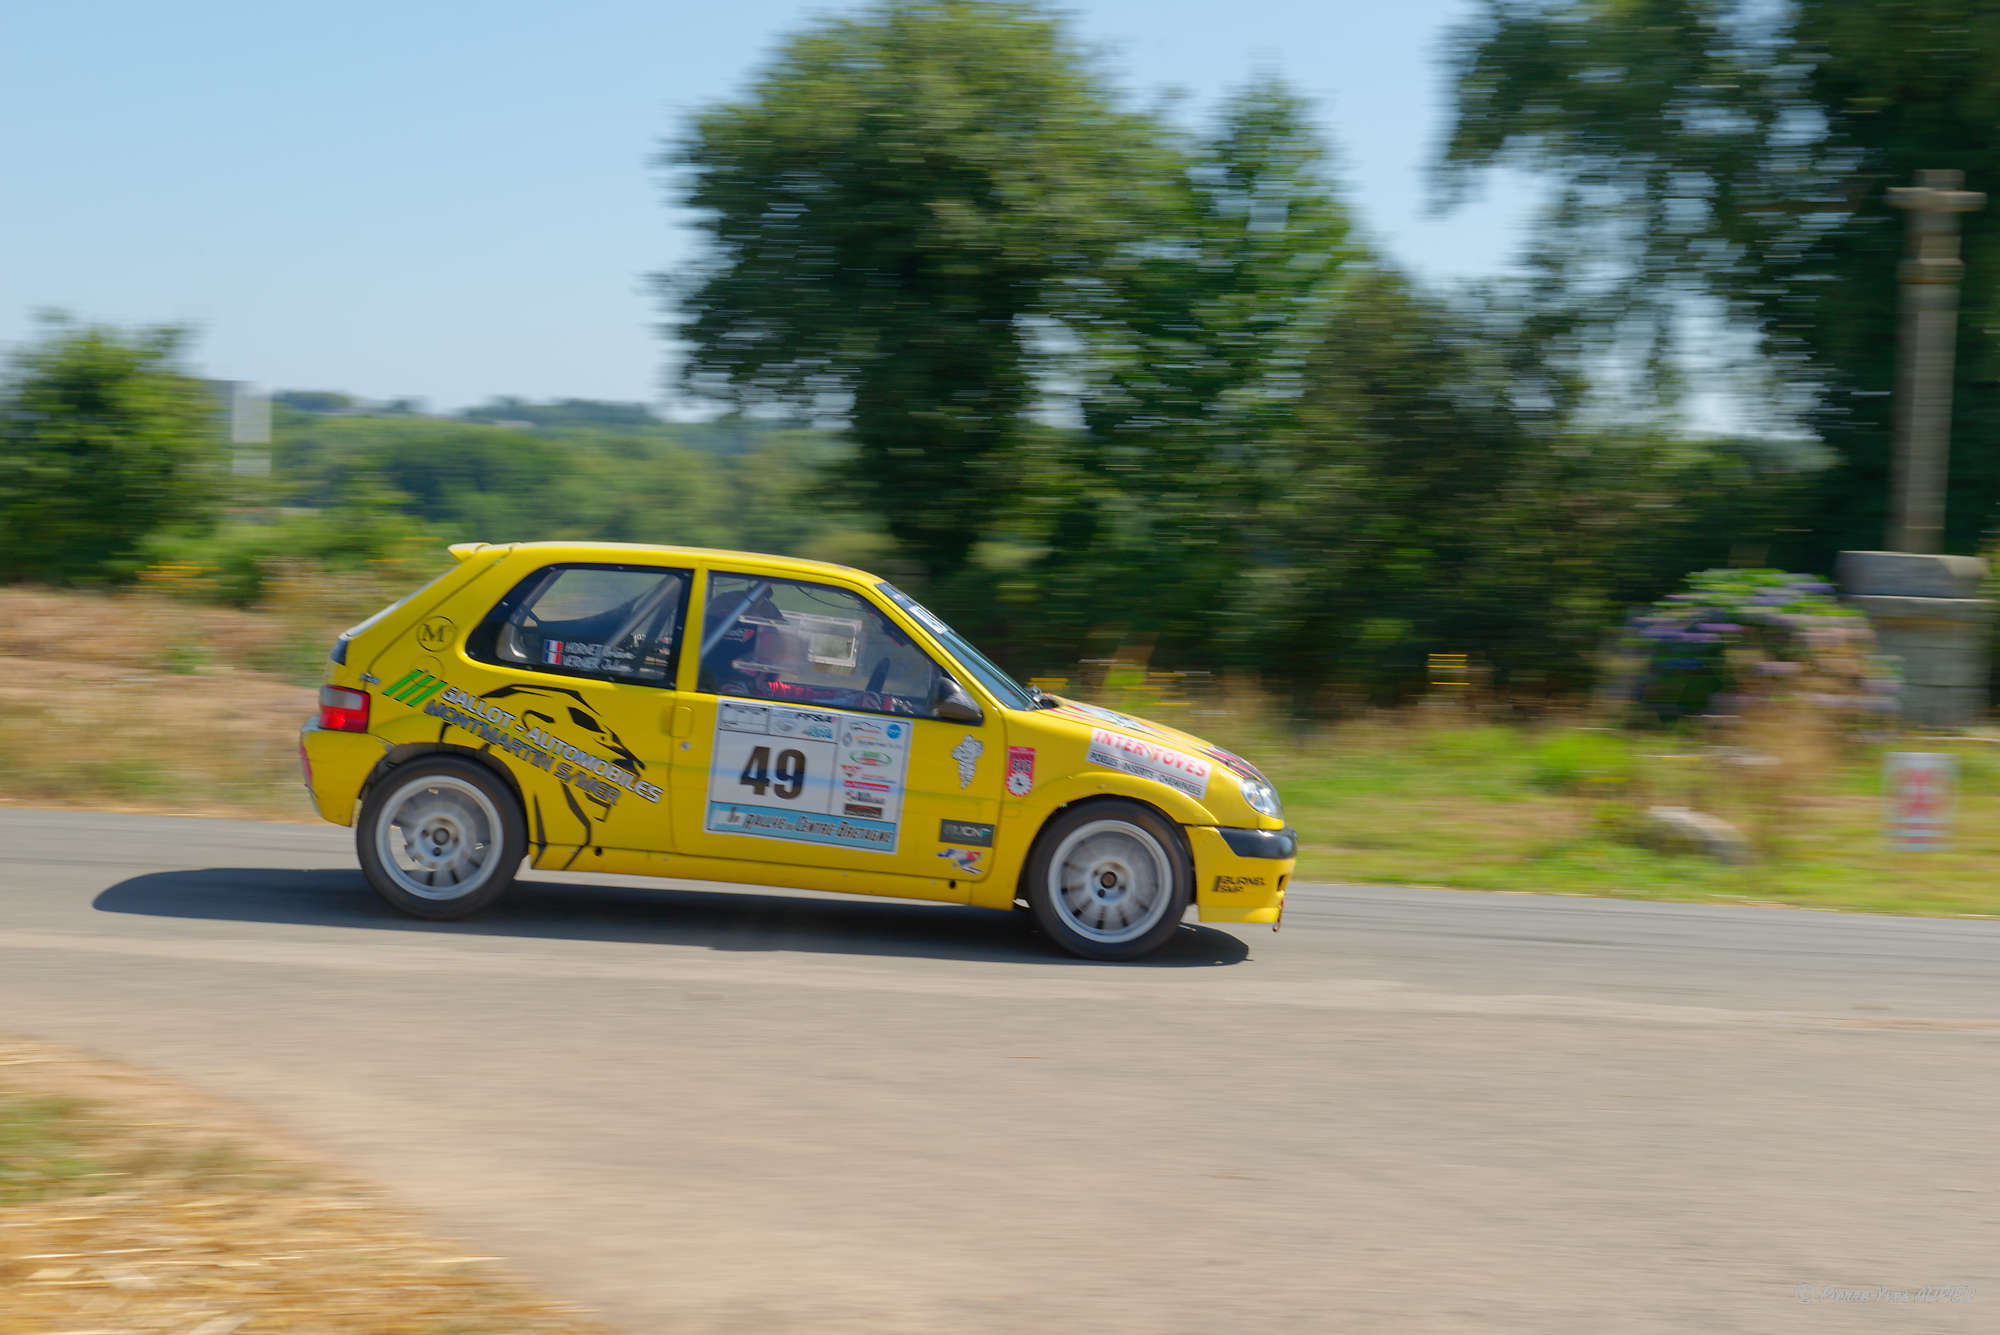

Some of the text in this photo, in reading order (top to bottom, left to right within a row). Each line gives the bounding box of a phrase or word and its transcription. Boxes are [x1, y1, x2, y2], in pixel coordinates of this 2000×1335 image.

[424, 699, 556, 773] MONTMARTIN
[441, 686, 516, 729] GALLOT
[523, 726, 664, 803] AUTOMOBILES
[1094, 730, 1145, 757] INTER
[739, 745, 807, 800] 49
